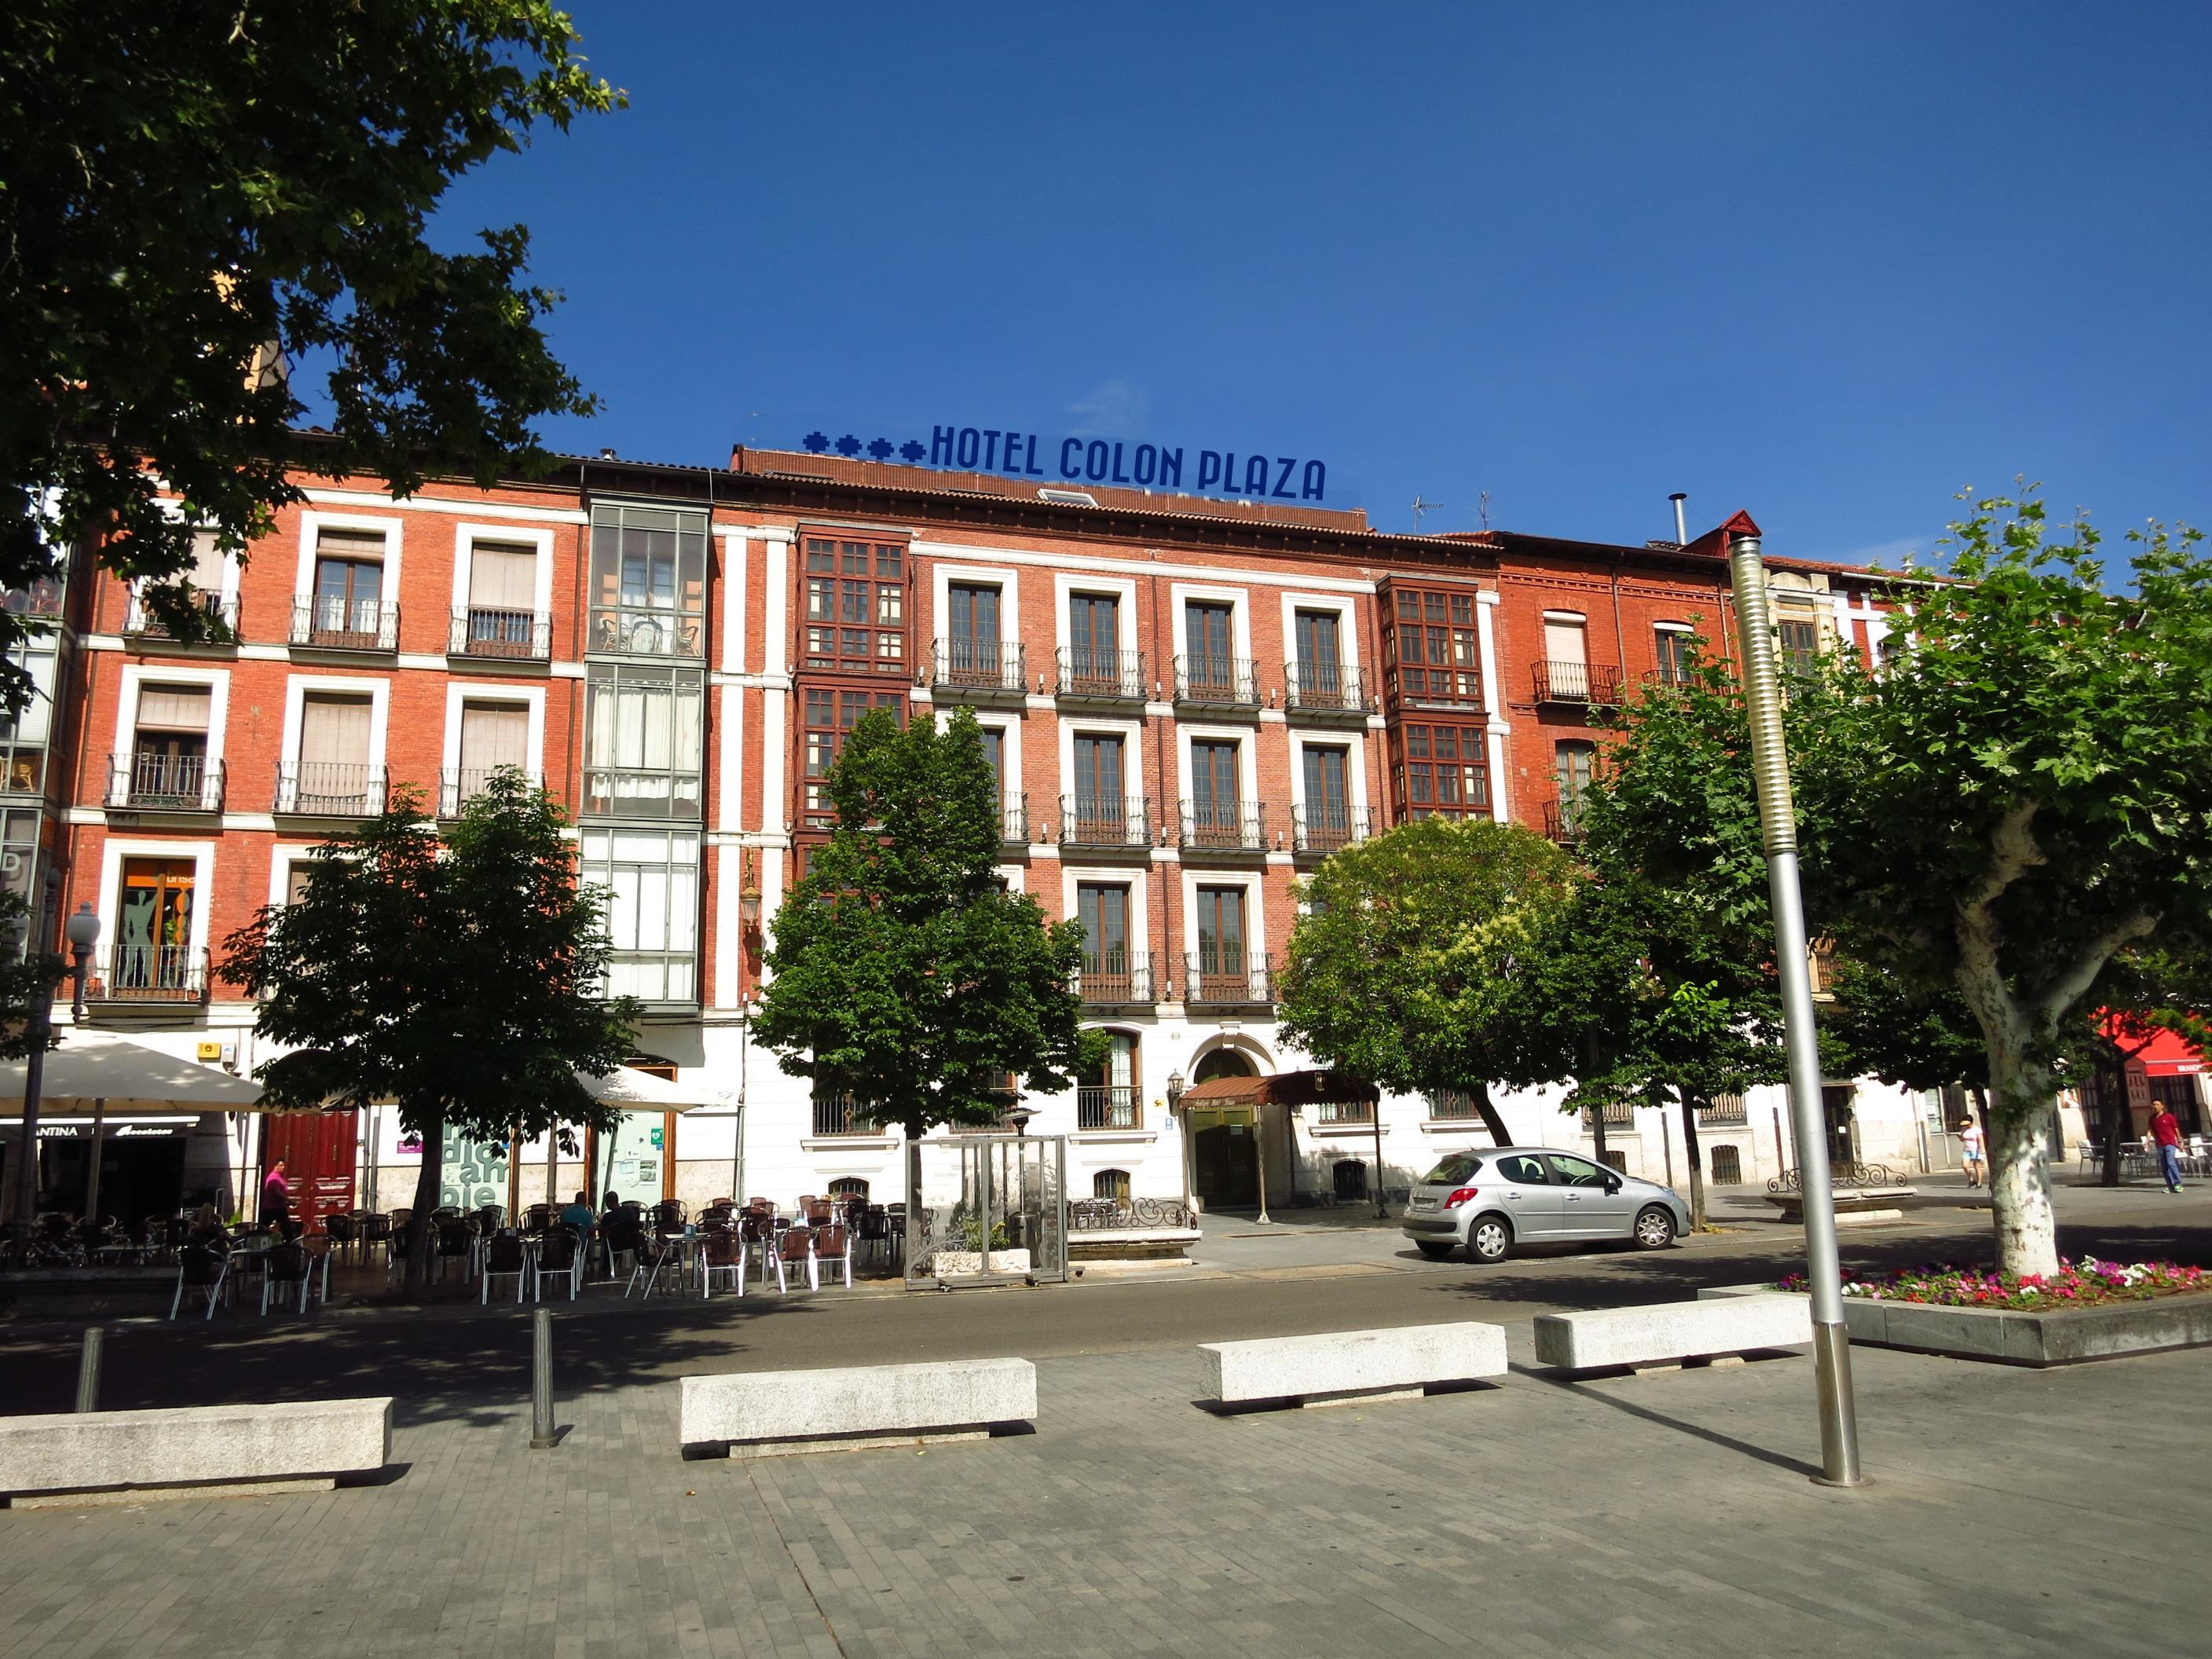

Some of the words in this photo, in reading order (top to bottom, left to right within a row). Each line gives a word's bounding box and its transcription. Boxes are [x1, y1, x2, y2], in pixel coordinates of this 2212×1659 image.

[930, 425, 1043, 475] HOTEL
[1060, 438, 1184, 488] COLON
[1197, 450, 1326, 501] PLAZA
